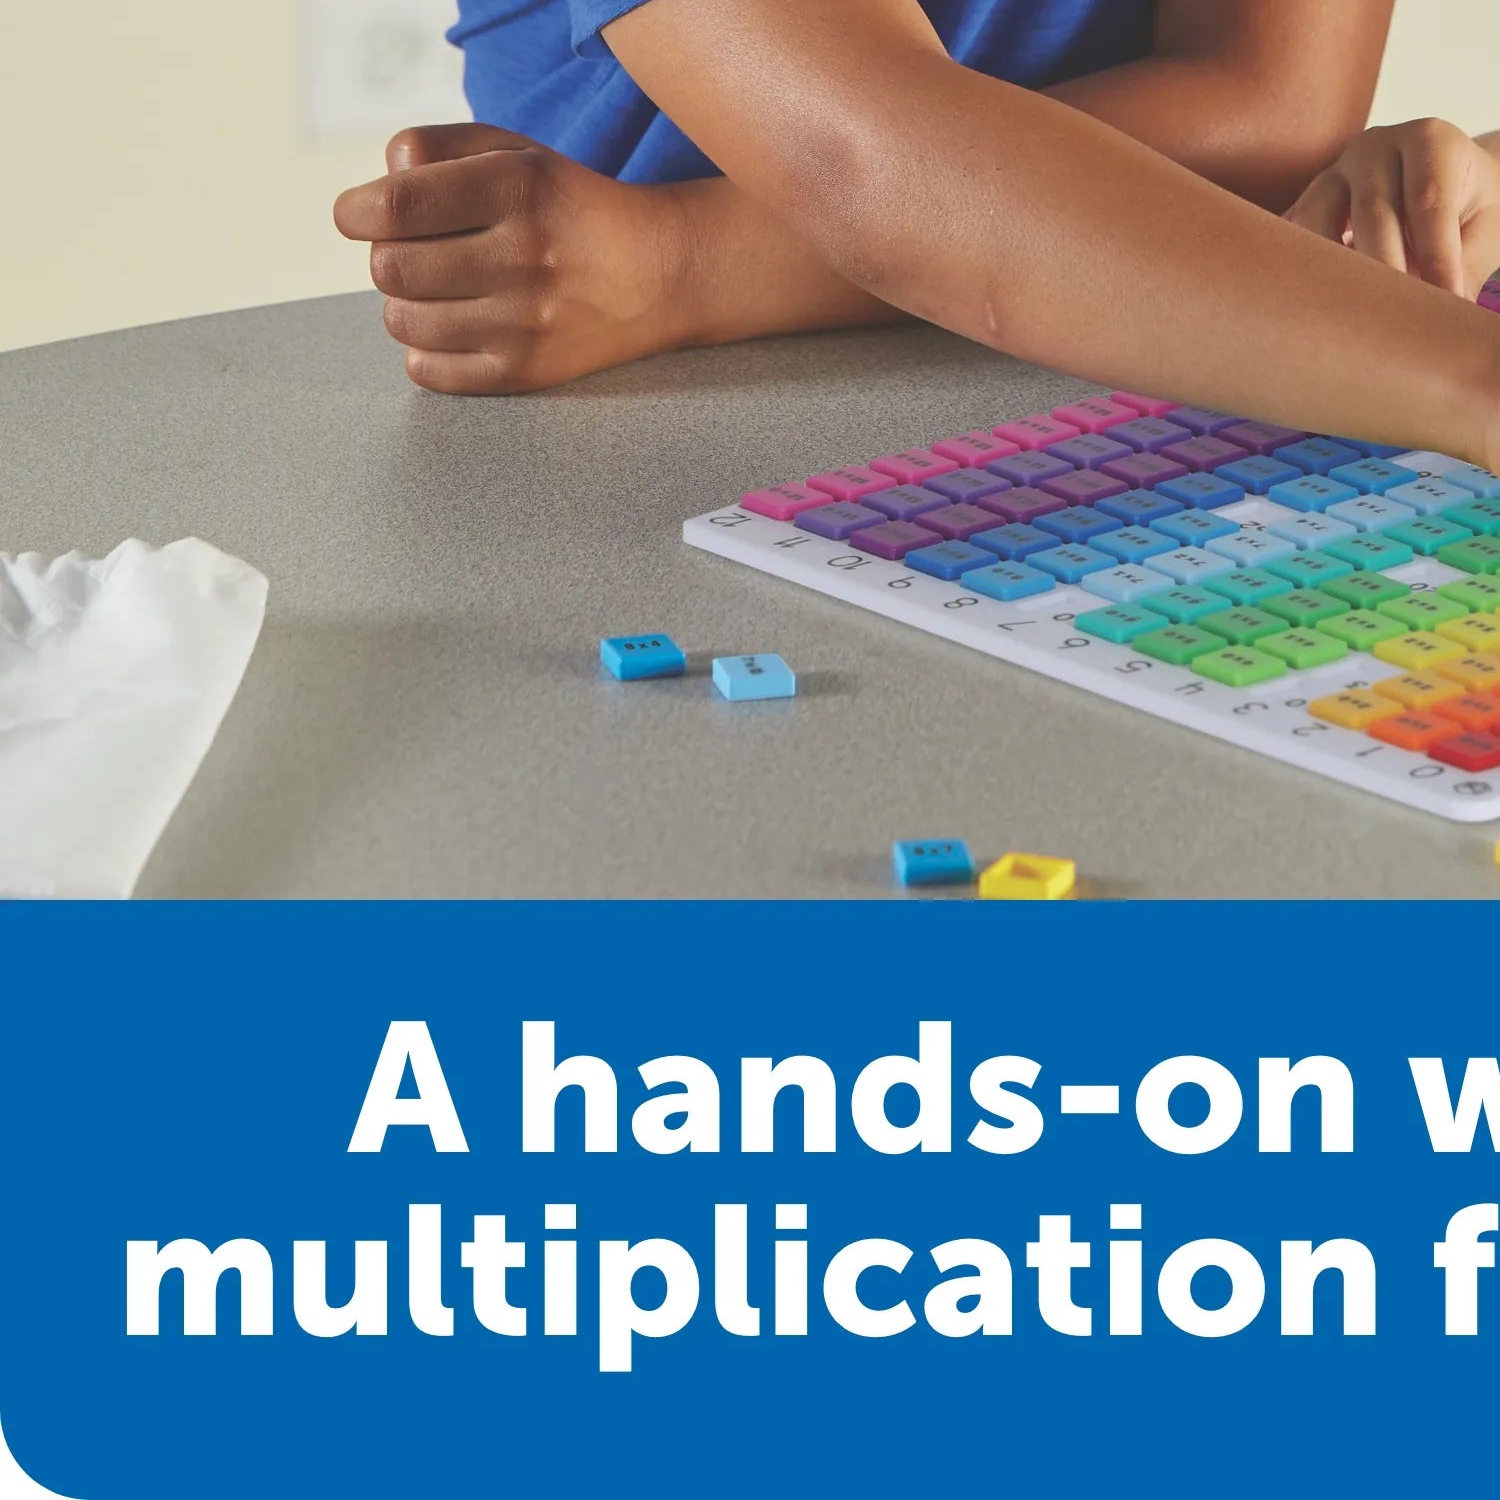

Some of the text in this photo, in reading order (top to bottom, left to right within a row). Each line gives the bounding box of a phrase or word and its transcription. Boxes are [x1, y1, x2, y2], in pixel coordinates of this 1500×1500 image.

[709, 513, 751, 528] 12
[773, 537, 810, 548] 11
[1235, 536, 1266, 550] 7x3
[827, 555, 872, 570] 10
[1174, 554, 1206, 567] 7x2
[943, 597, 979, 609] 8
[997, 620, 1036, 631] 7
[1114, 660, 1152, 674] 5
[1174, 682, 1204, 695] 4
[1232, 702, 1269, 715] 3
[1292, 723, 1328, 736] 2
[1355, 746, 1383, 757] 1
[1409, 765, 1444, 778] 0
